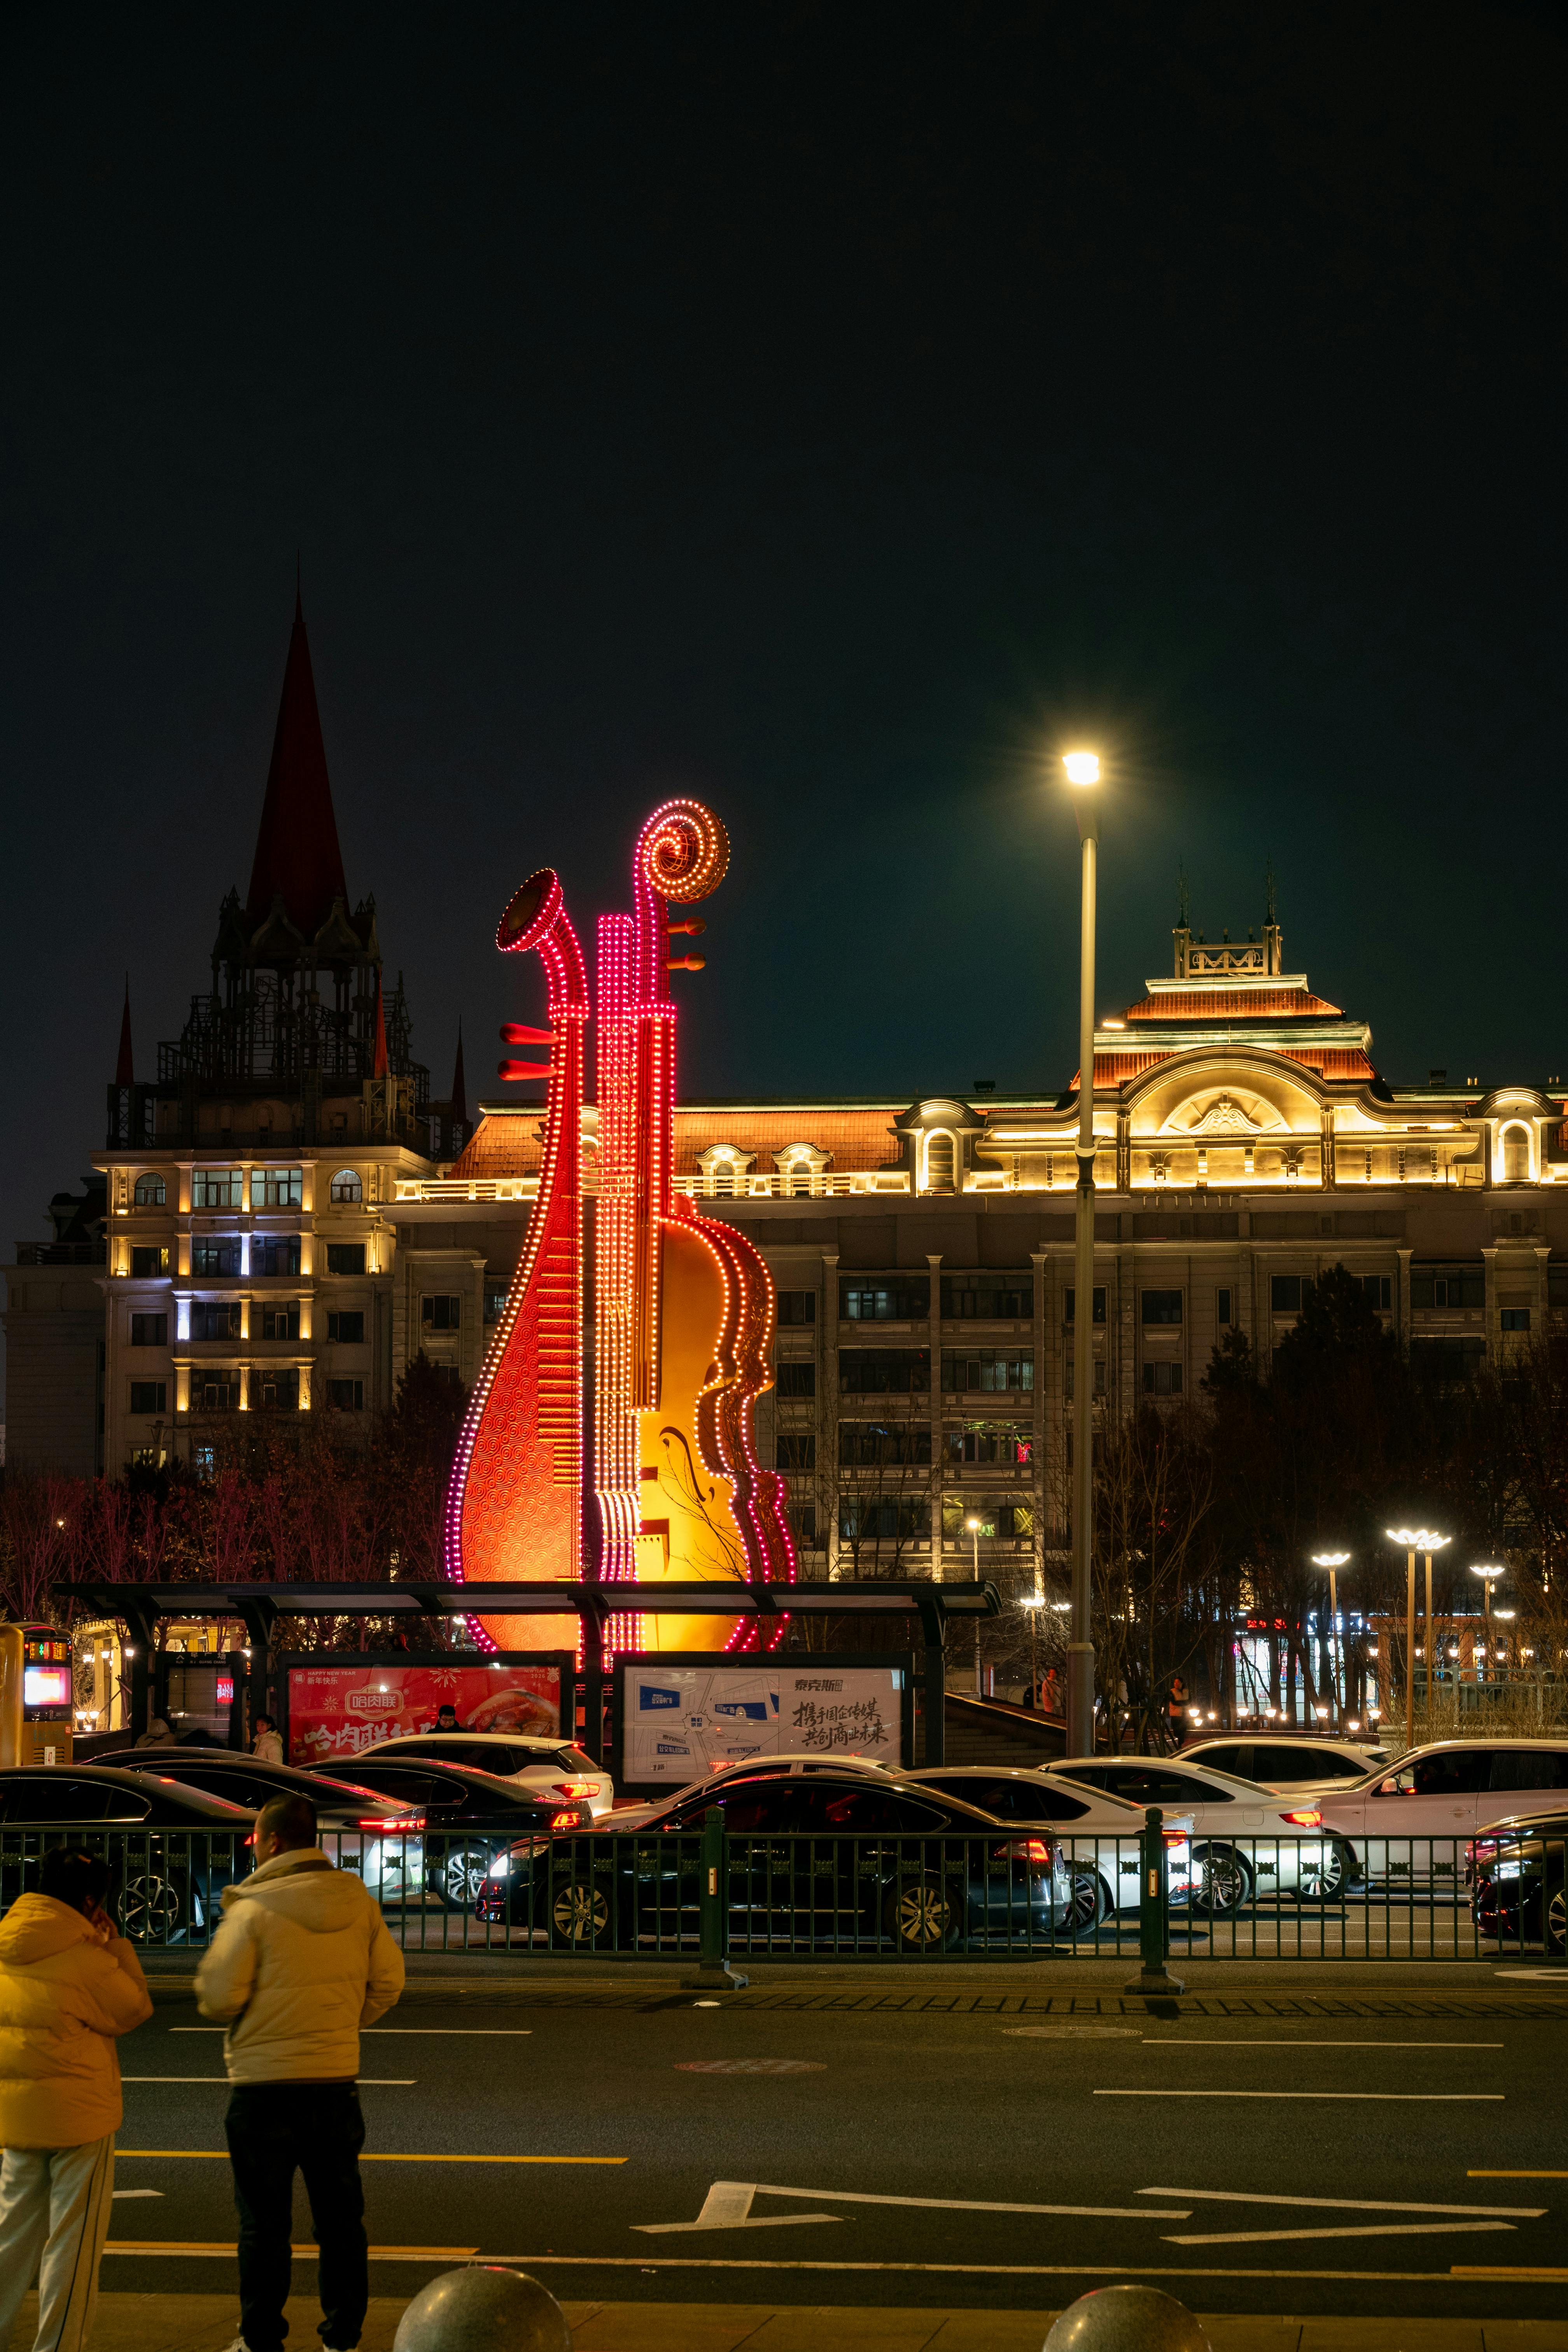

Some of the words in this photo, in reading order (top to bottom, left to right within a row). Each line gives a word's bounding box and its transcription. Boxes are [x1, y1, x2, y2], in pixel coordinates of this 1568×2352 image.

[352, 1695, 396, 1708] 哈肉联
[792, 1697, 884, 1727] 携手国企传媒
[802, 1718, 889, 1752] 共创商业未来
